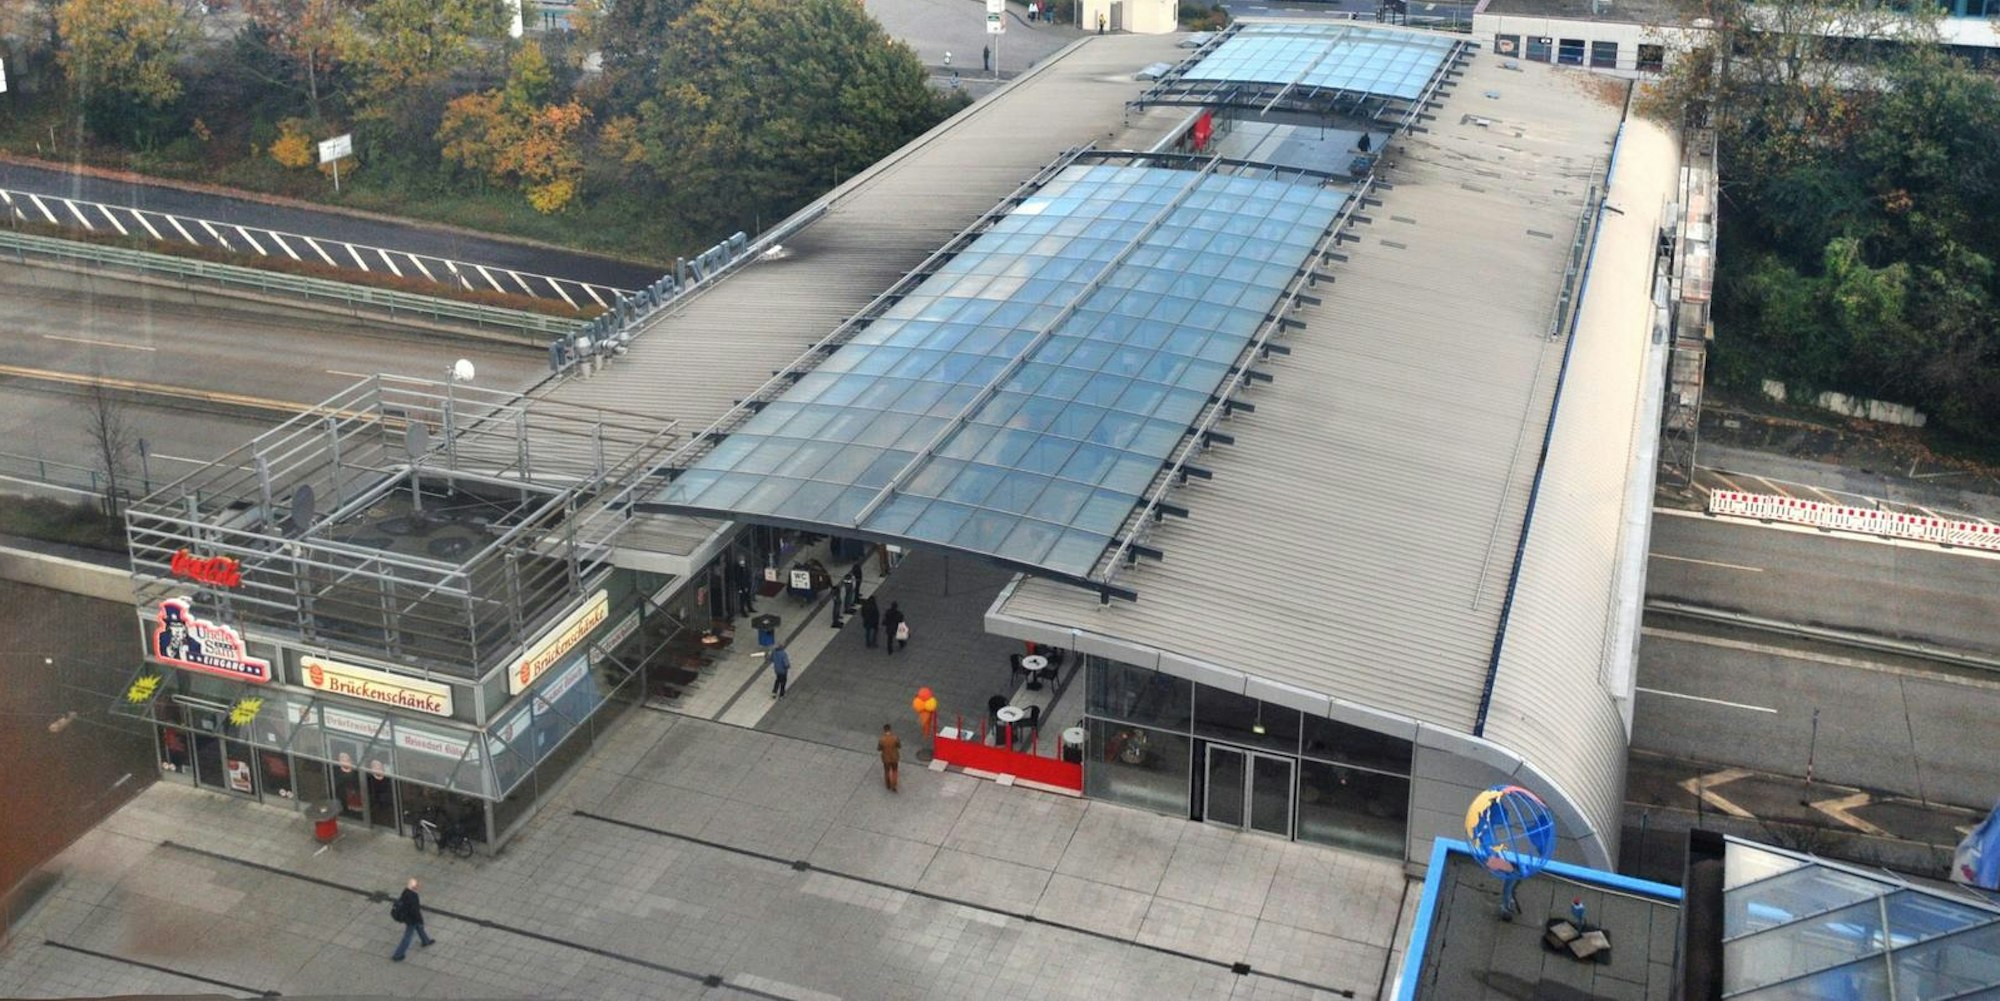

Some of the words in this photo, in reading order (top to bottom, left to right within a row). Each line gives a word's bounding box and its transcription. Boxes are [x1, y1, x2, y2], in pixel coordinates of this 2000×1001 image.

[793, 572, 807, 580] WC
[196, 624, 234, 643] Uncle
[204, 640, 235, 659] Sam
[203, 656, 246, 672] EINGANG
[329, 677, 442, 713] Brückenschänke
